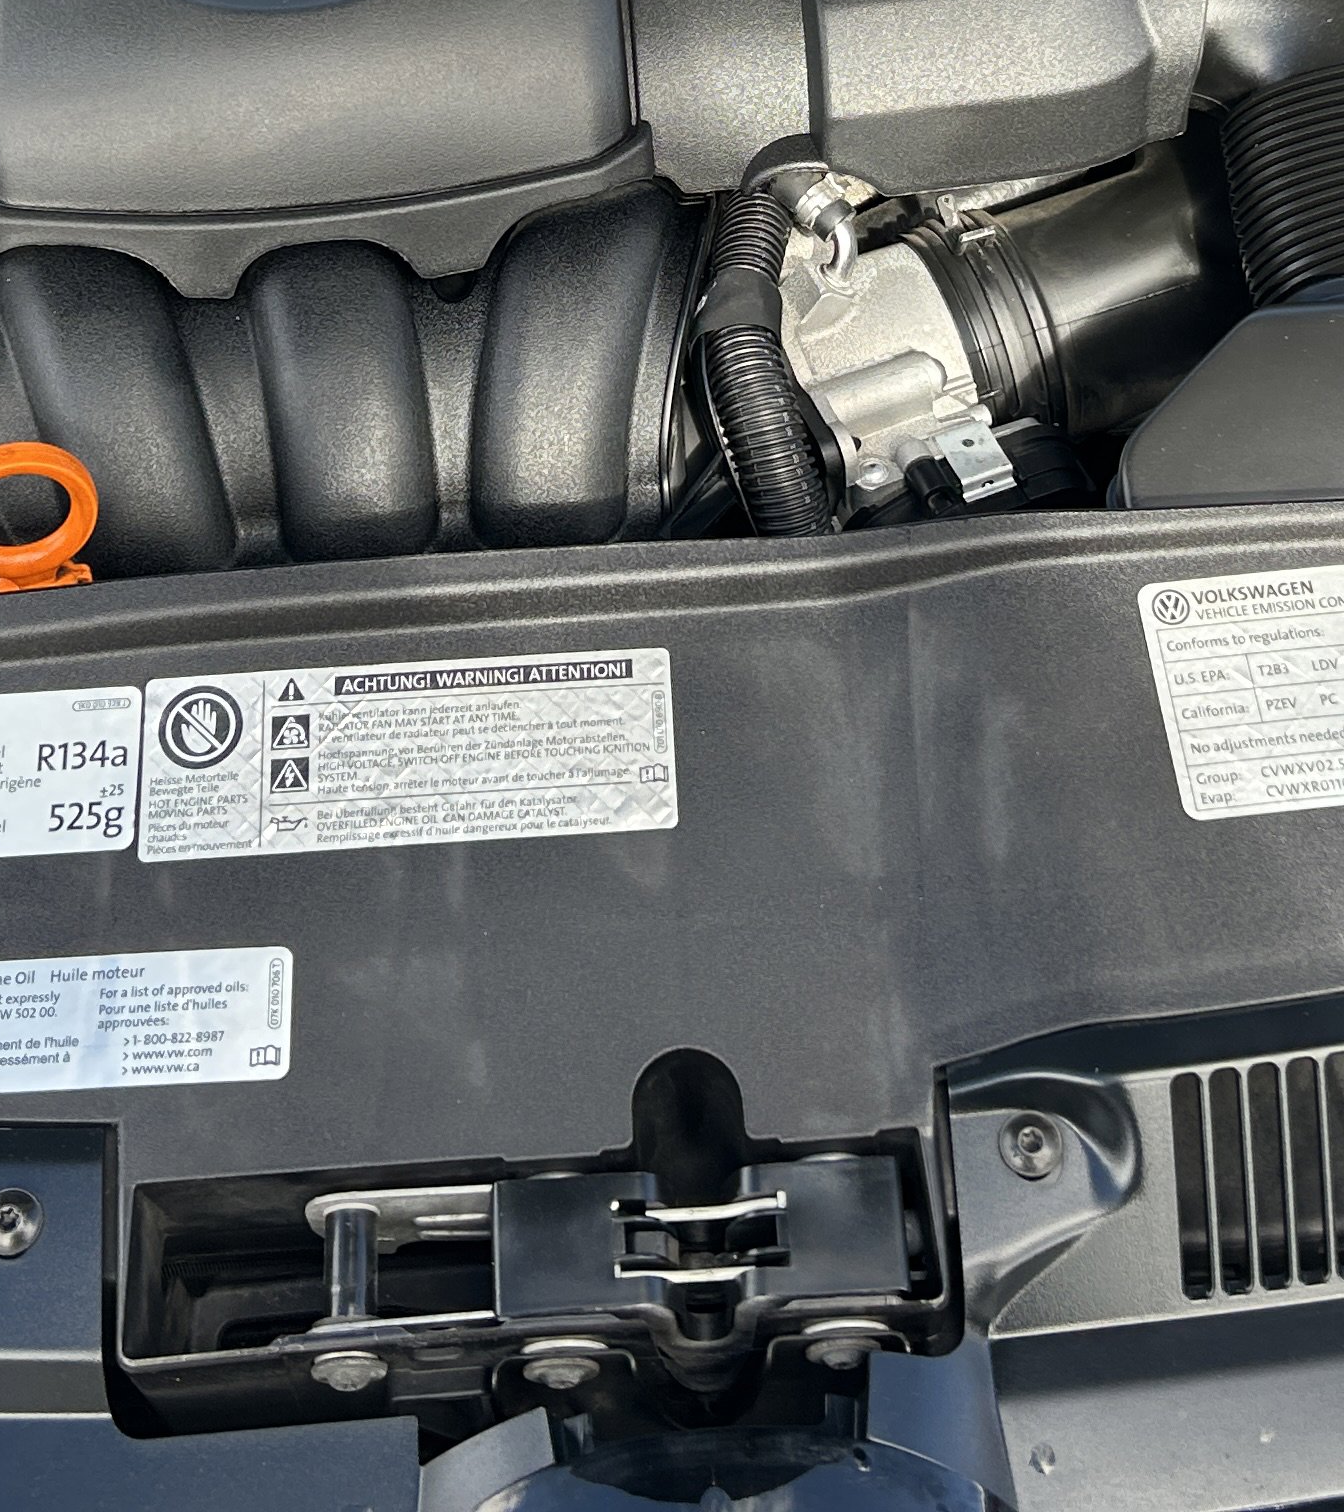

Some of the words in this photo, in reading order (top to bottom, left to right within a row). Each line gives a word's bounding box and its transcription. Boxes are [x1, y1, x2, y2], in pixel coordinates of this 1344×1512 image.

[1190, 580, 1314, 605] VOLKSWAGEN
[1195, 604, 1249, 620] VEHICLE
[1252, 598, 1315, 615] EMISSION
[1165, 634, 1229, 652] Conforms
[1231, 633, 1246, 645] to
[1257, 663, 1289, 676] T2B3
[1311, 658, 1339, 671] LDV
[342, 673, 430, 693] ACHTUNG!
[436, 667, 524, 687] WARNING!
[529, 661, 626, 682] ATTENTION!
[1180, 701, 1249, 719] California:
[1265, 697, 1298, 710] PZEV
[1319, 693, 1338, 705] PC
[372, 719, 391, 729] FAN
[395, 717, 417, 728] MAY
[421, 715, 450, 726] START
[453, 714, 463, 724] AT
[468, 713, 488, 723] ANY
[1189, 741, 1210, 754] No
[1211, 731, 1298, 754] adjustments
[37, 738, 128, 772] R134a
[318, 761, 344, 771] HIGH
[397, 755, 437, 766] SWITCH
[440, 754, 459, 764] OFF
[463, 751, 501, 762] ENGINE
[504, 748, 541, 760] BEFORE
[544, 745, 600, 757] TOUCHING
[602, 742, 650, 753] IGNITION
[1195, 769, 1242, 787] Group:
[99, 783, 124, 798] ±25
[1199, 789, 1237, 807] Evap:
[149, 798, 171, 808] HOT
[174, 796, 213, 807] ENGINE
[217, 793, 247, 804] PARTS
[47, 799, 124, 842] 525g
[148, 808, 193, 819] MOVING
[196, 805, 227, 816] PARTS
[317, 818, 376, 830] OVERFILLED
[380, 815, 418, 826] ENGINE
[421, 814, 436, 824] OIL
[443, 812, 465, 822] CAN
[468, 809, 513, 821] DAMAGE
[14, 971, 35, 984] Oil
[50, 968, 88, 982] Huile
[92, 964, 145, 980] moteur
[5, 990, 60, 1007] expressly
[99, 987, 118, 999] For
[131, 985, 148, 997] list
[151, 984, 165, 996] of
[166, 981, 221, 998] approved
[14, 1007, 36, 1019] 502
[98, 1003, 125, 1014] Pour
[128, 1004, 151, 1013] une
[154, 1000, 178, 1012] liste
[25, 1037, 40, 1049] de
[132, 1047, 212, 1060] www.vw.com
[131, 1062, 199, 1074] www.vw.ca
